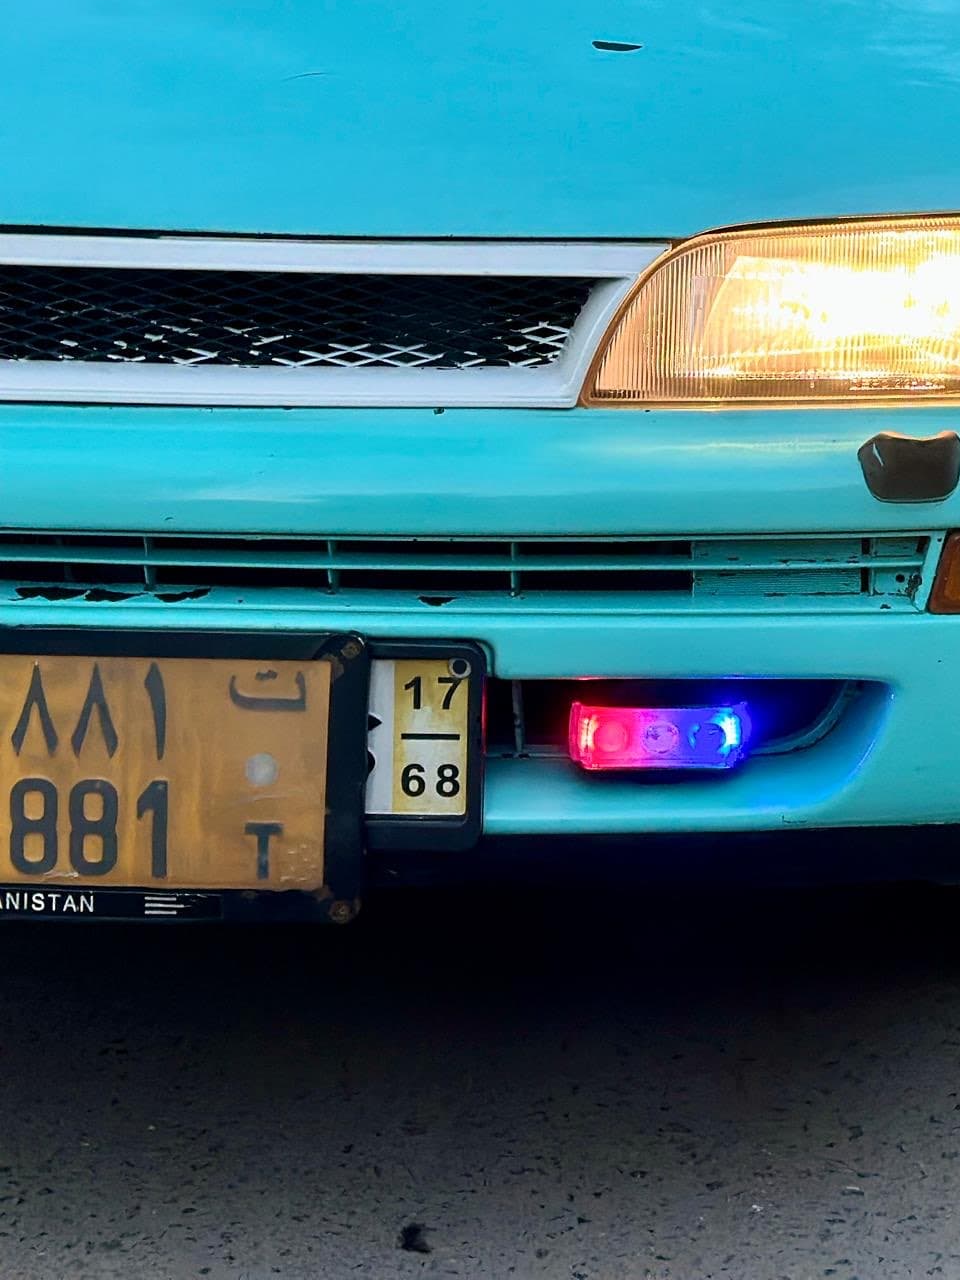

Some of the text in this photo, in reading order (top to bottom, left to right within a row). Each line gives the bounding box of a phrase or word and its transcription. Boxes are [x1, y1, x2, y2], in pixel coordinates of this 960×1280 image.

[404, 676, 463, 710] 17
[401, 764, 461, 797] 68
[9, 778, 284, 880] 881 T
[0, 892, 95, 913] NISTAN
